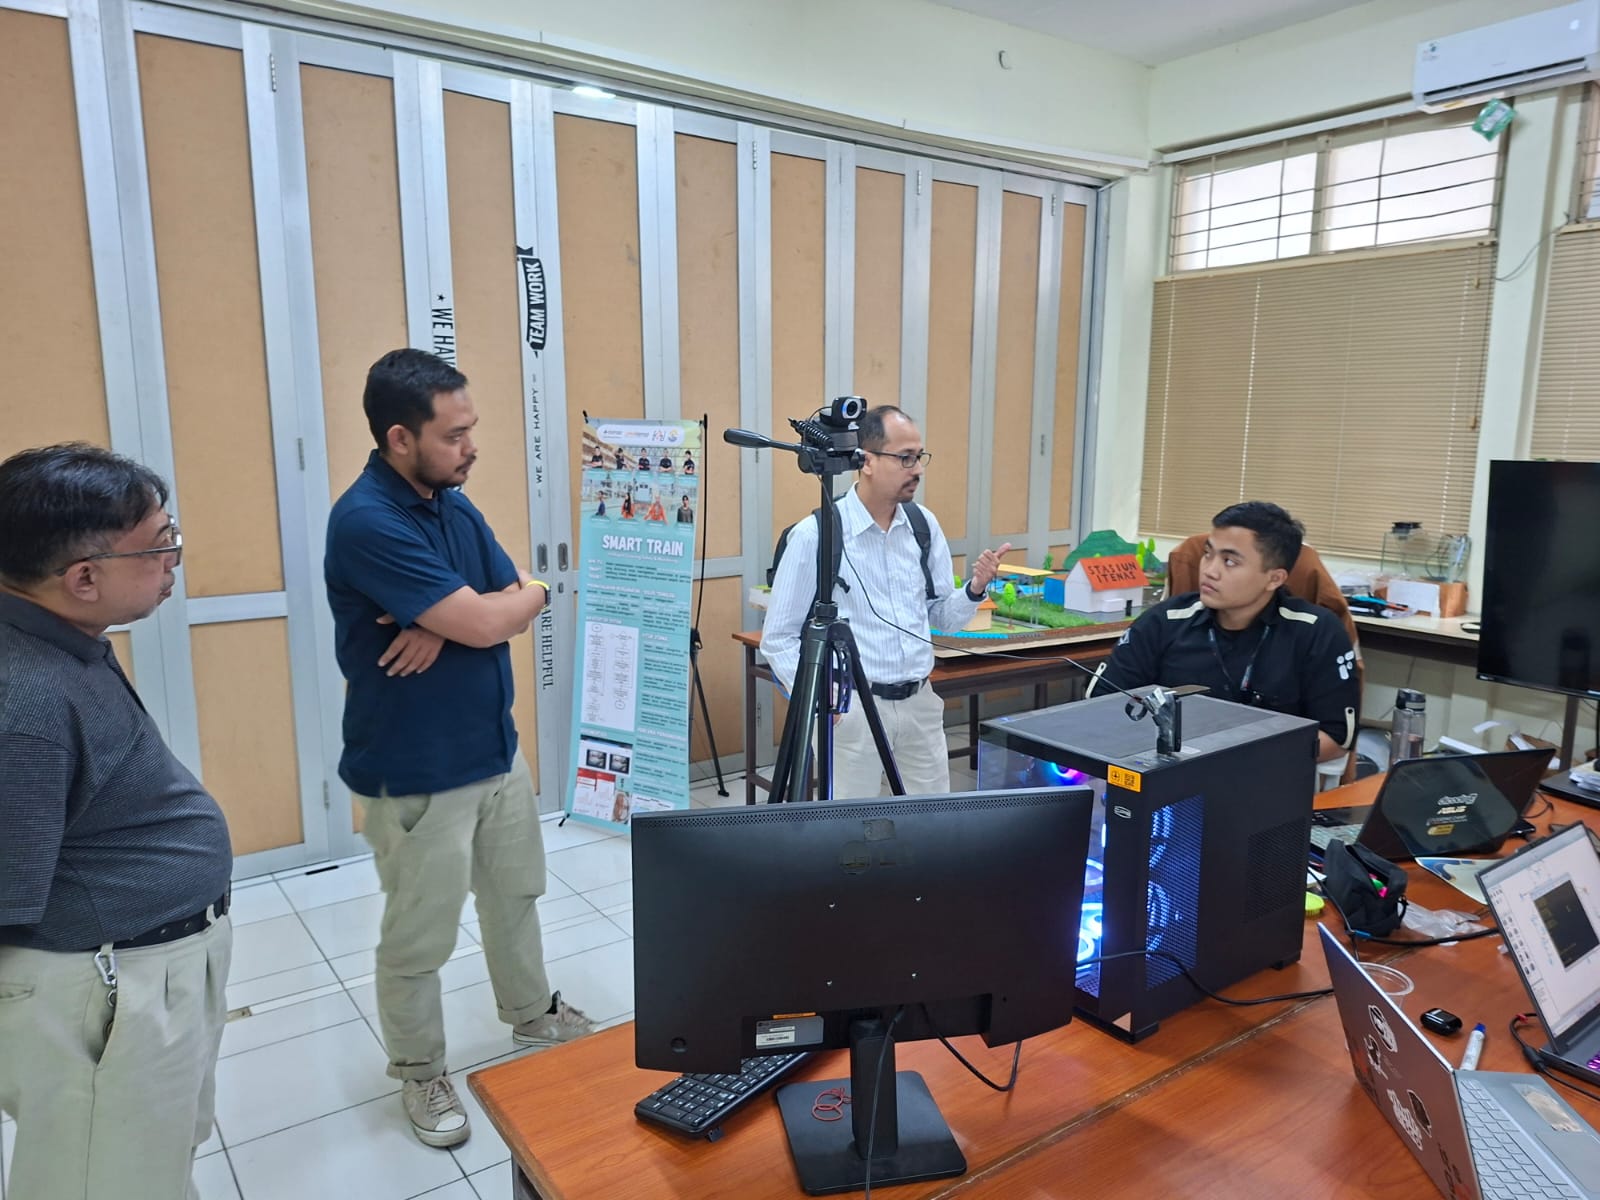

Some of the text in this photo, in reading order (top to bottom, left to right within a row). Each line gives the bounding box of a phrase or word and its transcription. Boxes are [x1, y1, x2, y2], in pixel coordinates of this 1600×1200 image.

[525, 262, 545, 344] TEAM WORK
[432, 308, 456, 366] WE HAV
[532, 388, 543, 484] WE ARE HAPPY
[602, 534, 684, 557] SMART TRAIN
[1087, 562, 1137, 575] STASIUN
[1096, 571, 1137, 584] ITENAS
[541, 635, 554, 691] HELPFUL
